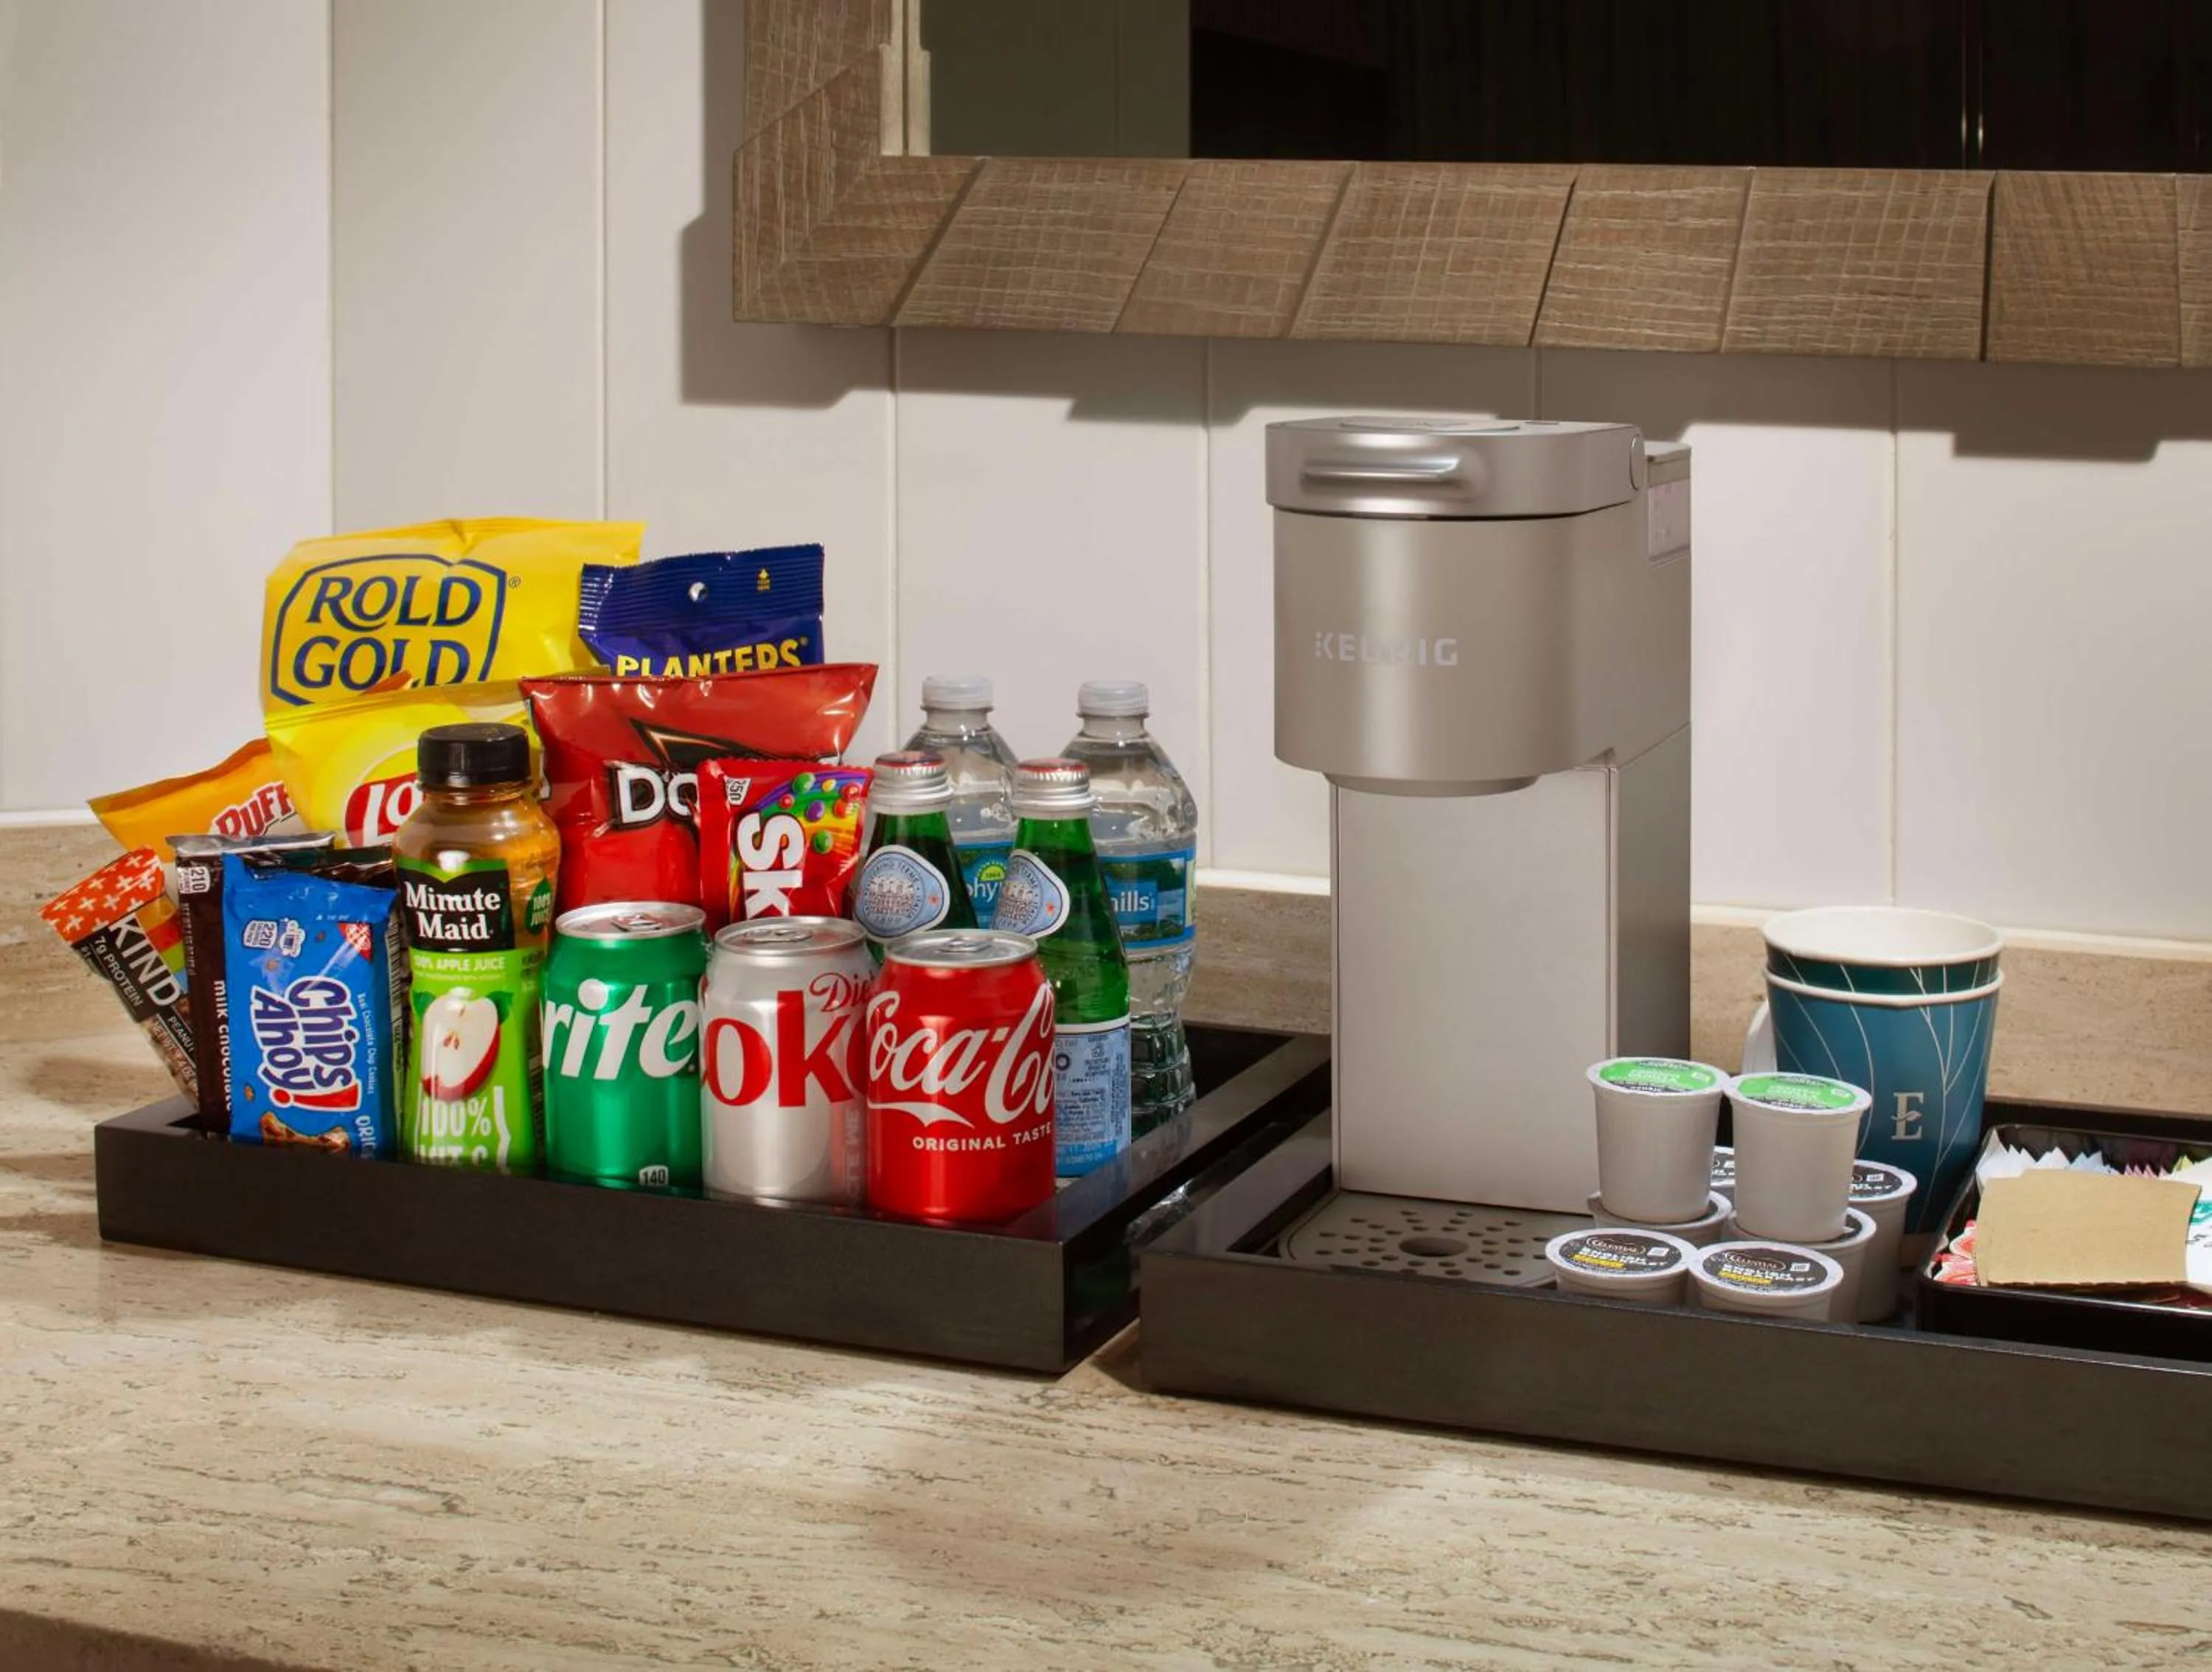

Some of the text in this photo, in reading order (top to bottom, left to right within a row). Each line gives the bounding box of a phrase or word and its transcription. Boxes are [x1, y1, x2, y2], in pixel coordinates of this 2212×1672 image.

[306, 576, 482, 632] ROLD
[293, 635, 470, 690] GOLD
[1315, 631, 1458, 666] KEUIG
[191, 868, 206, 892] 210
[404, 882, 501, 912] Minute
[259, 923, 274, 947] 220
[417, 911, 490, 940] Maid
[94, 936, 108, 955] 7g
[103, 953, 144, 1008] PROTEIN
[108, 913, 181, 1008] KIND
[473, 957, 506, 971] JUICE
[288, 980, 356, 1087] Chips
[700, 977, 869, 1107] ok
[422, 1097, 492, 1137] 100%
[912, 1121, 1051, 1152] ORIGINAL TASTE
[643, 1169, 666, 1185] 140
